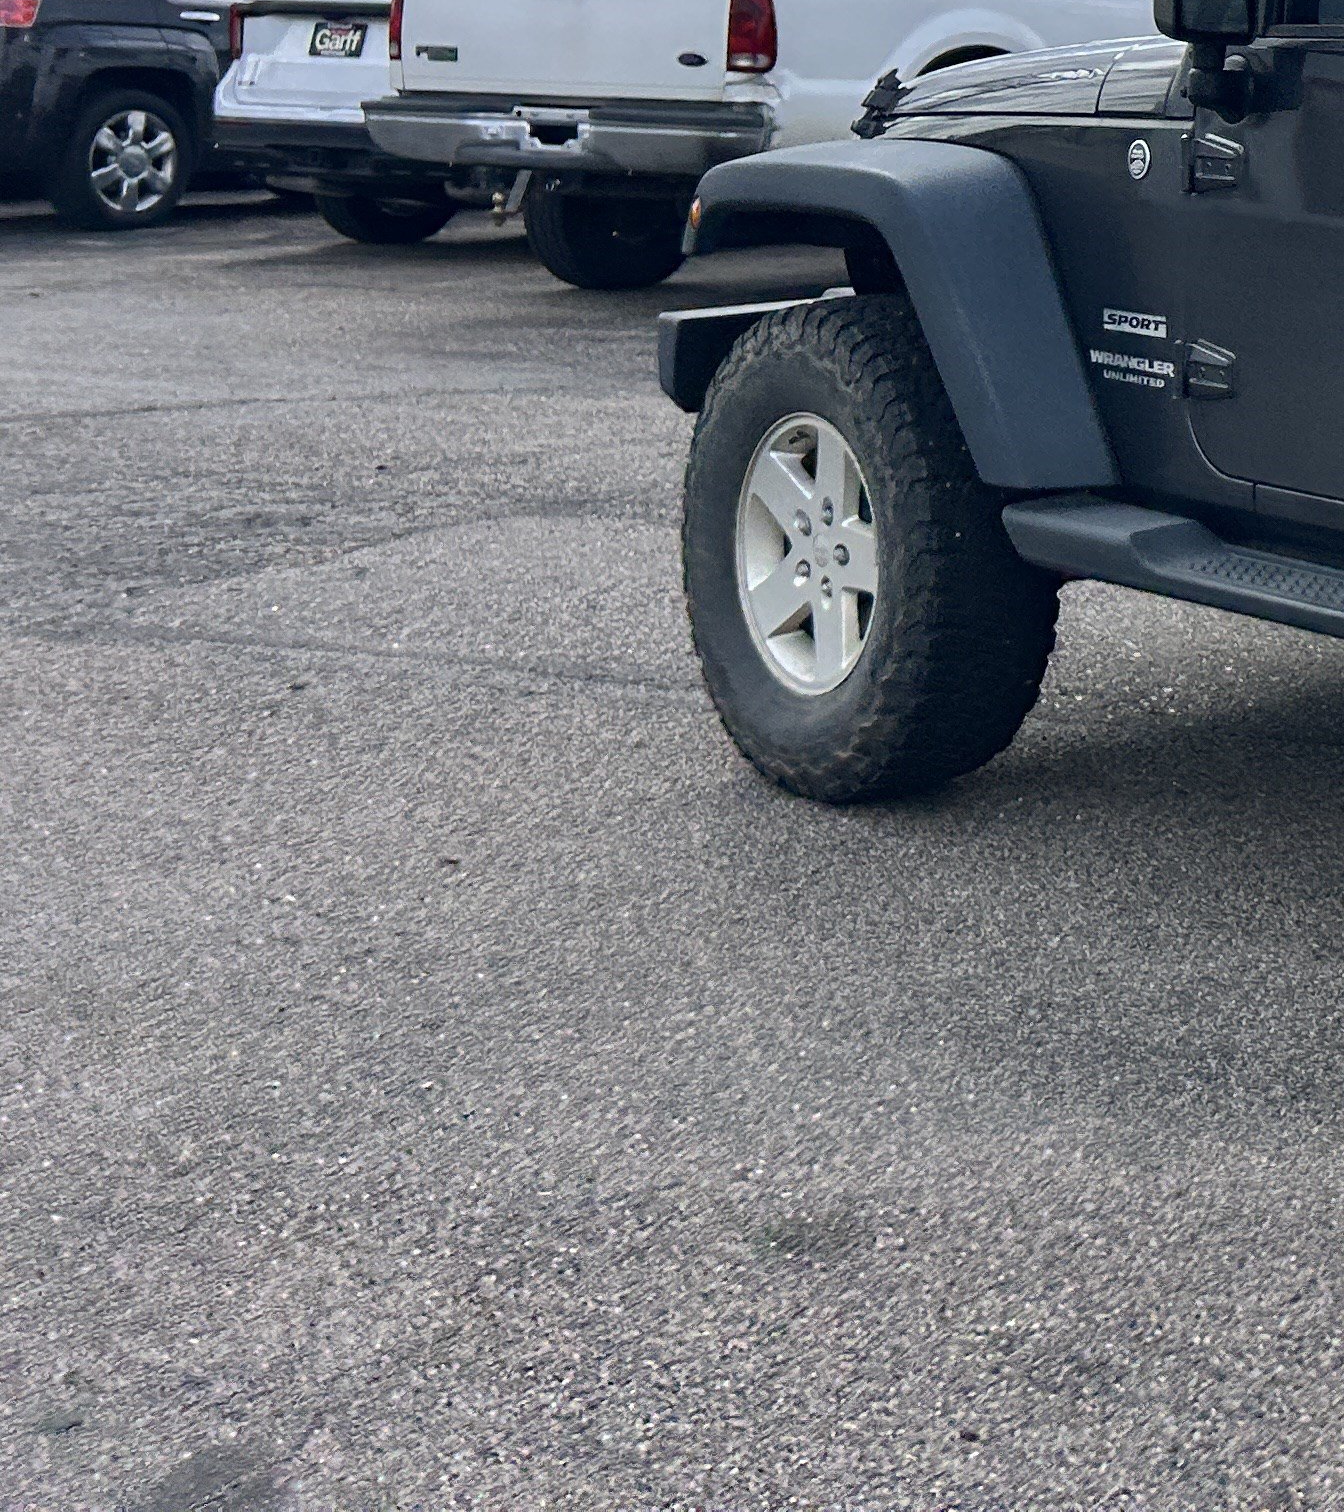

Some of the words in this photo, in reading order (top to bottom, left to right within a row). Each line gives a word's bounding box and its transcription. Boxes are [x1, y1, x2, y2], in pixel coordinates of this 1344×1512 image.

[1104, 313, 1166, 332] SPORT
[1090, 349, 1175, 378] WRANGLER
[1103, 369, 1165, 388] UNLIMITED
